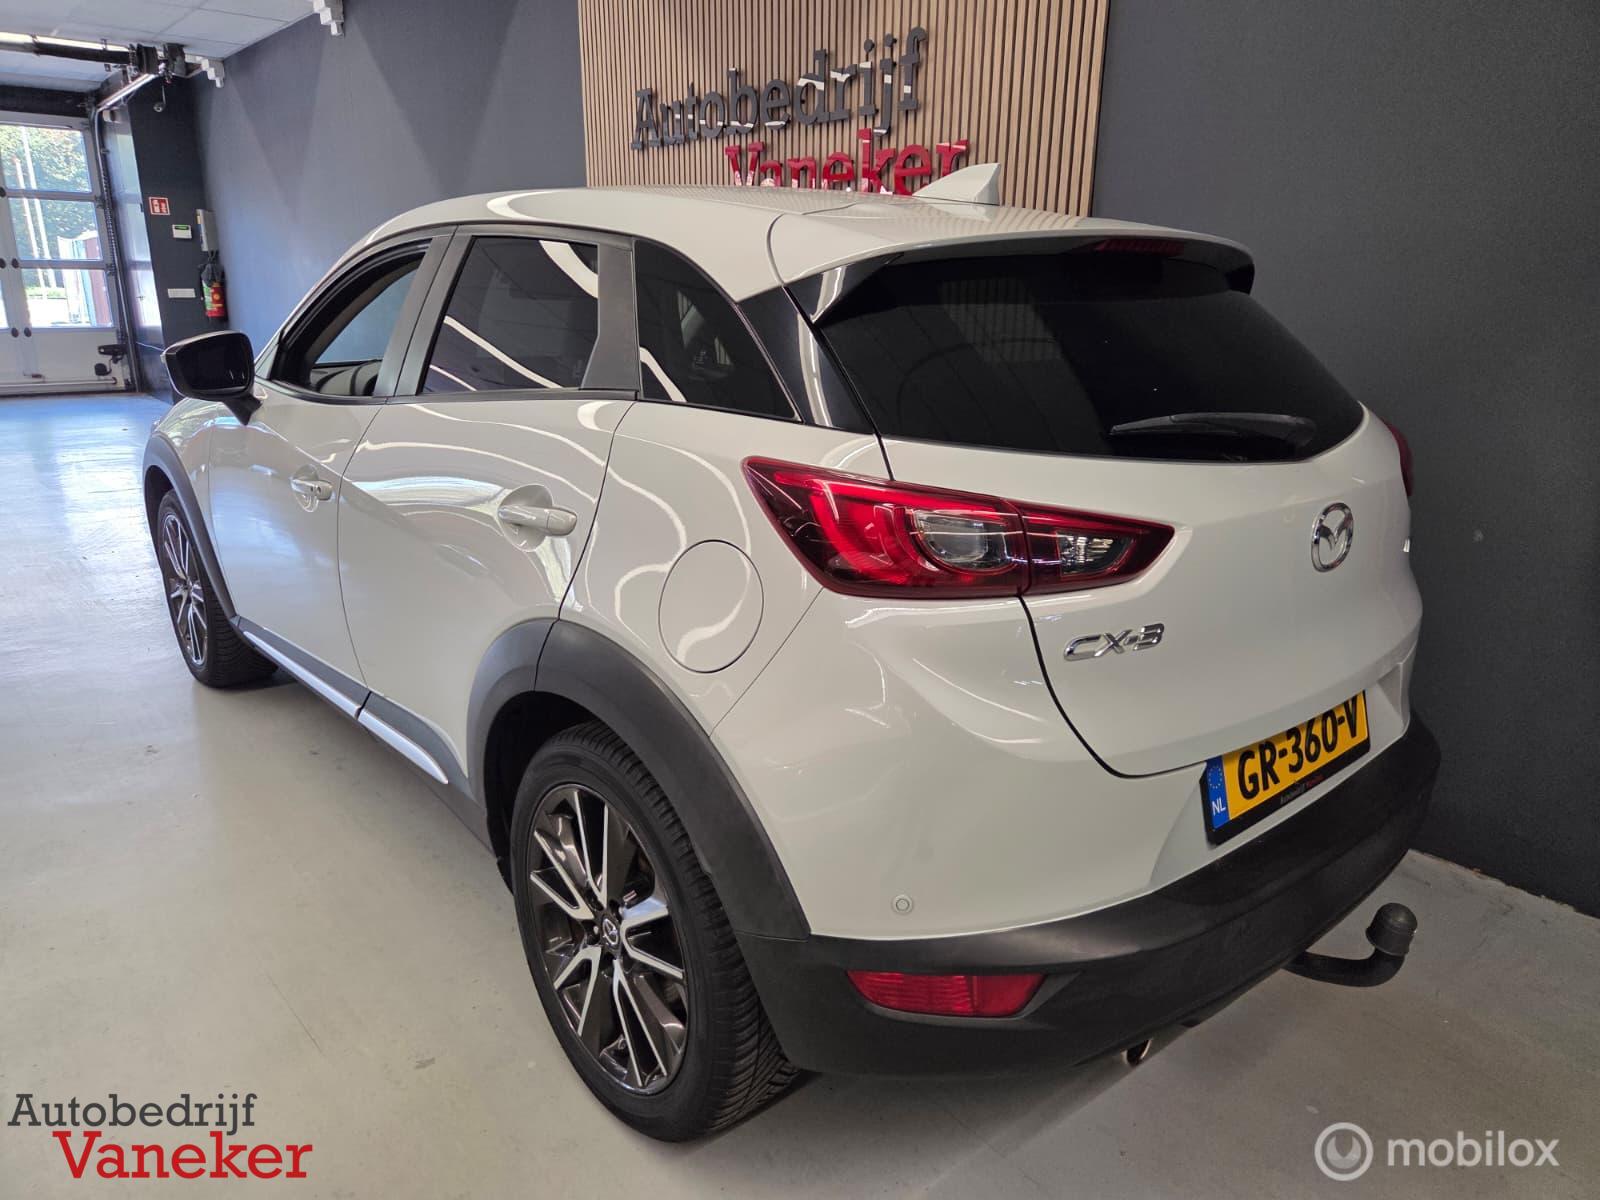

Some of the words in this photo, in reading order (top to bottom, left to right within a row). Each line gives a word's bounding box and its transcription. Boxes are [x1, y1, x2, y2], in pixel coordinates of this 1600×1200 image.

[631, 26, 927, 150] Autobedrijf
[724, 127, 970, 197] Vaneker
[1063, 623, 1165, 662] CX-3
[1237, 694, 1358, 801] GR-360-V
[1211, 796, 1227, 816] NL
